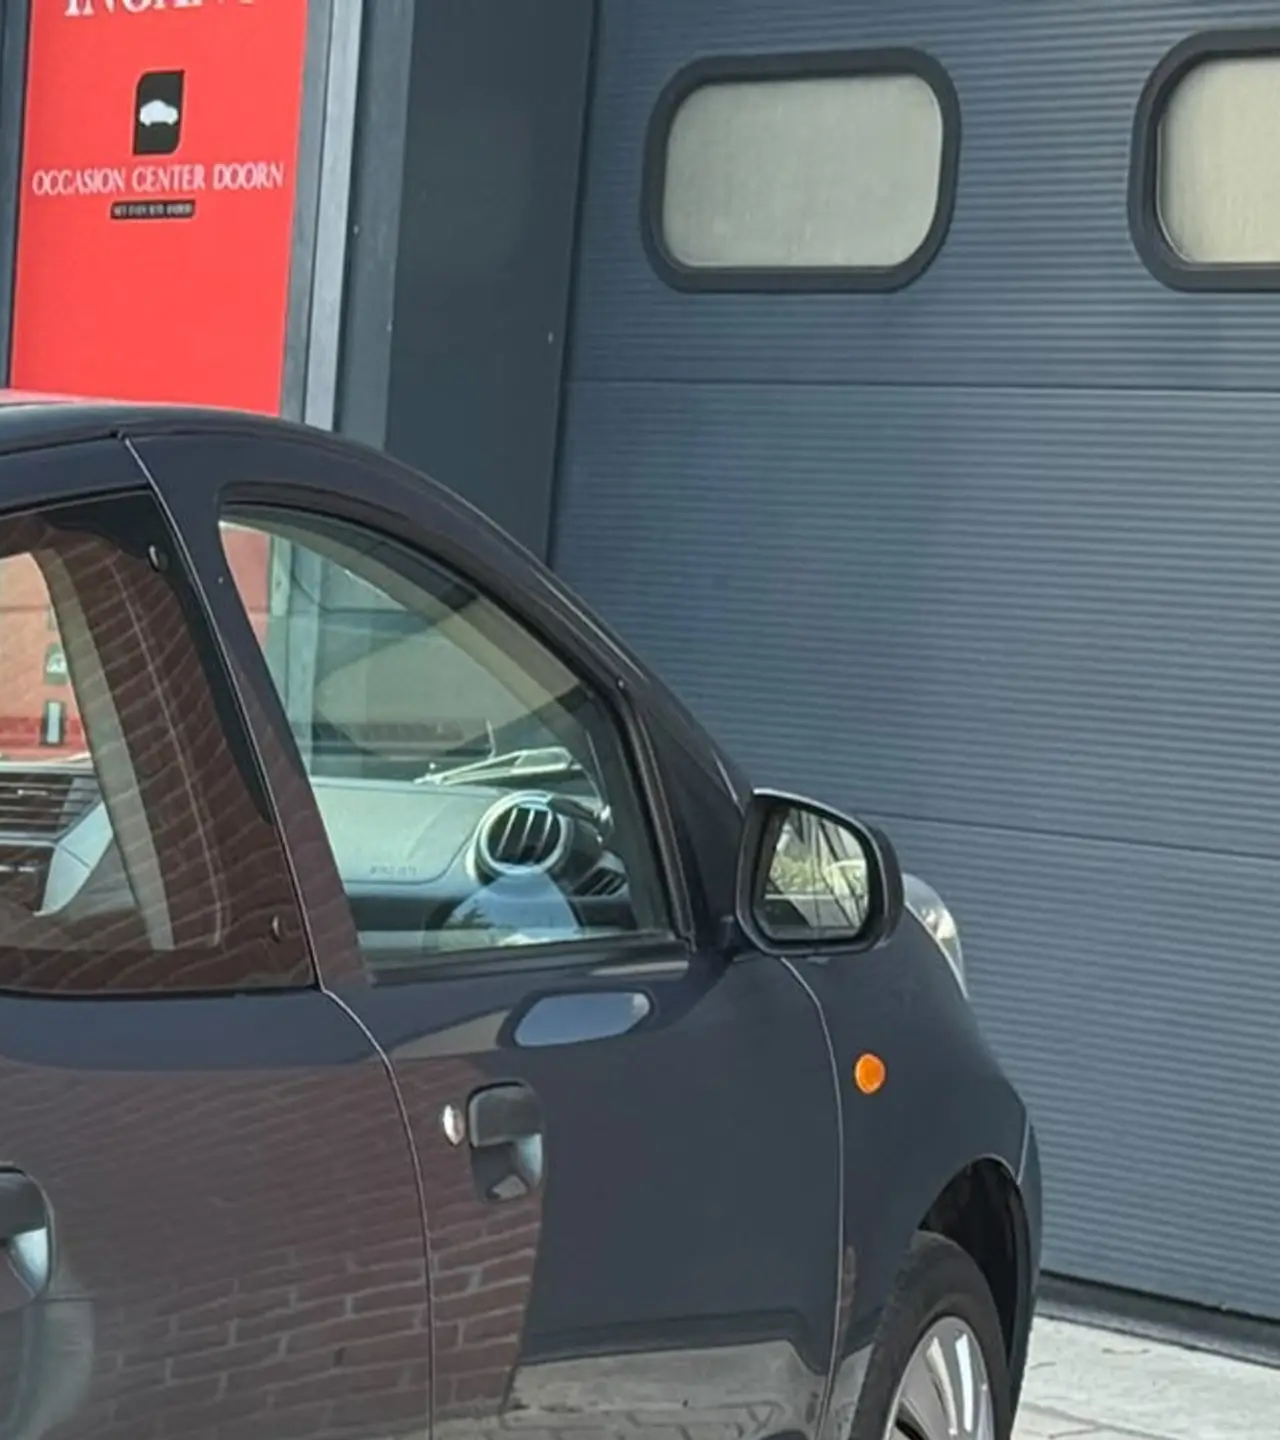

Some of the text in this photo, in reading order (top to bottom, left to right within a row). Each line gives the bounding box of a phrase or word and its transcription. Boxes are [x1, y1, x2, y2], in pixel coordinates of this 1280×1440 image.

[32, 160, 285, 196] OCCASION CENTER DOORN
